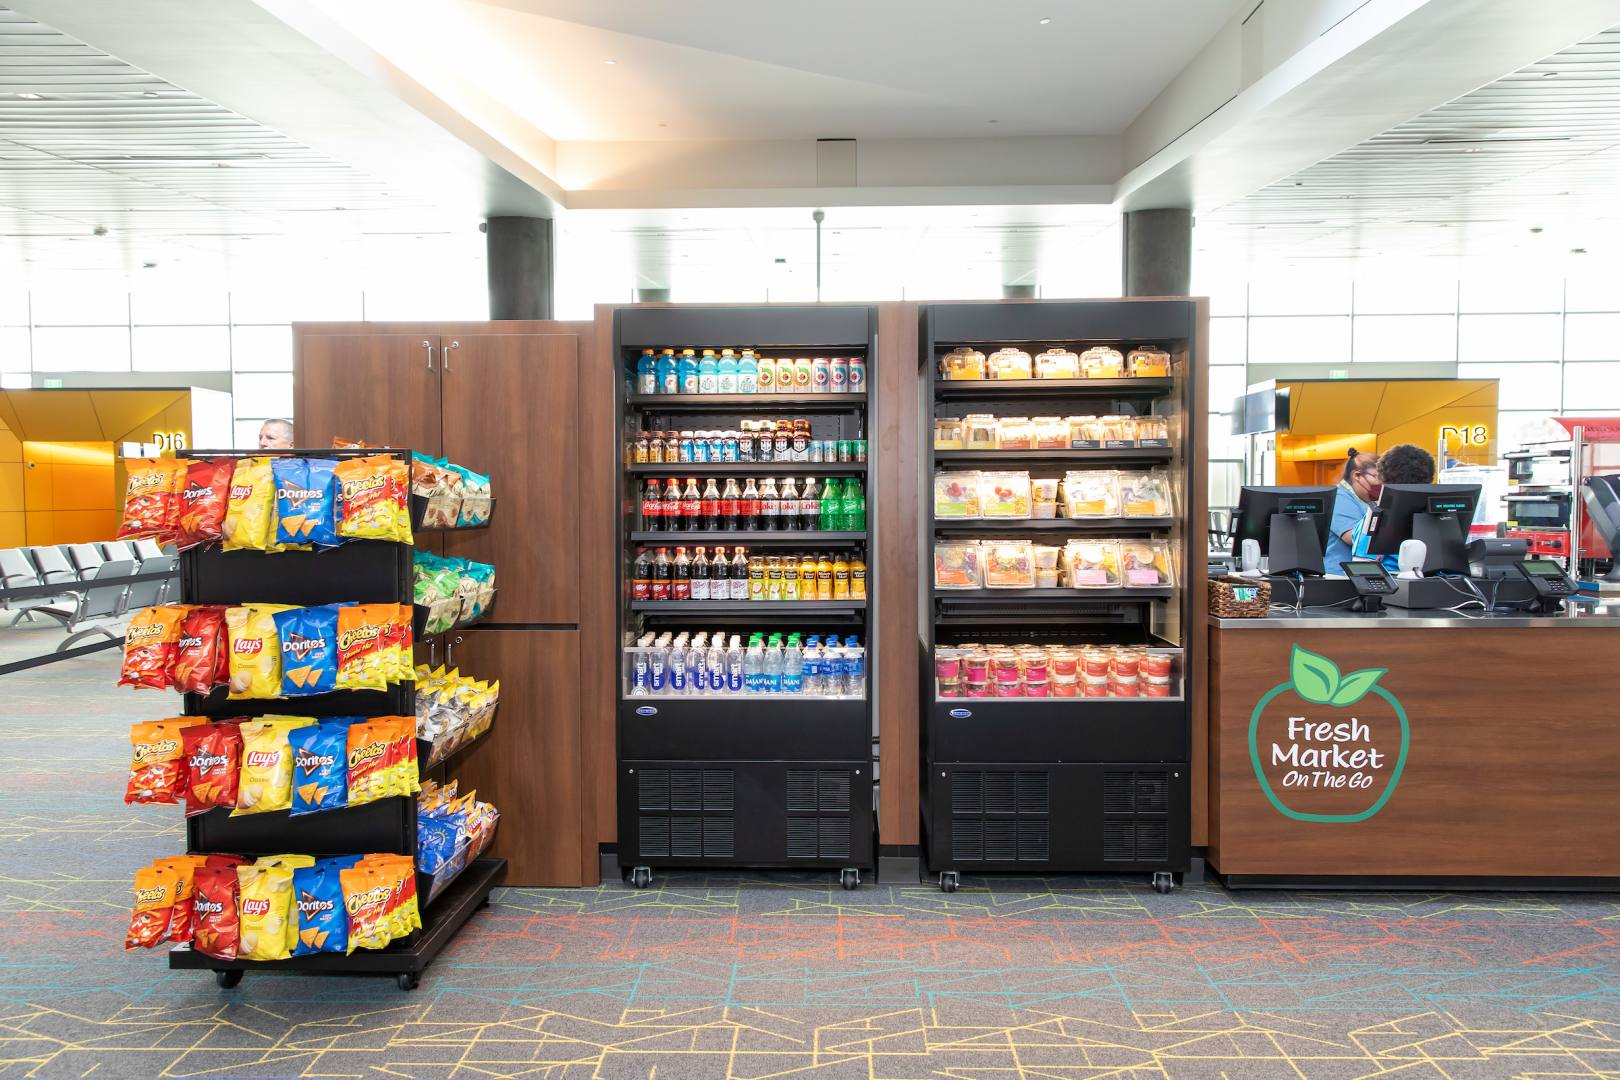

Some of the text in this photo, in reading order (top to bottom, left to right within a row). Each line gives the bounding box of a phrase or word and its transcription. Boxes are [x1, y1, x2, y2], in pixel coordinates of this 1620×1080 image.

[152, 433, 183, 450] D16
[184, 486, 212, 500] Doritos
[278, 488, 323, 500] Doritos
[344, 475, 386, 500] Cheetos
[126, 624, 164, 646] Cheetos
[339, 626, 379, 652] Cheetos
[235, 638, 262, 654] Lay's
[283, 639, 326, 652] Doritos
[1288, 717, 1370, 742] Fresh
[135, 740, 176, 762] Cheetos
[349, 742, 386, 770] Cheetos
[1272, 743, 1384, 768] Market
[189, 756, 228, 767] Doritos
[248, 752, 280, 768] Lay's
[295, 755, 334, 768] Doritos
[1282, 770, 1373, 788] On The Go
[194, 900, 222, 912] Doritos
[244, 900, 269, 916] Lay's
[297, 900, 334, 912] Doritos
[346, 888, 391, 916] Cheetos
